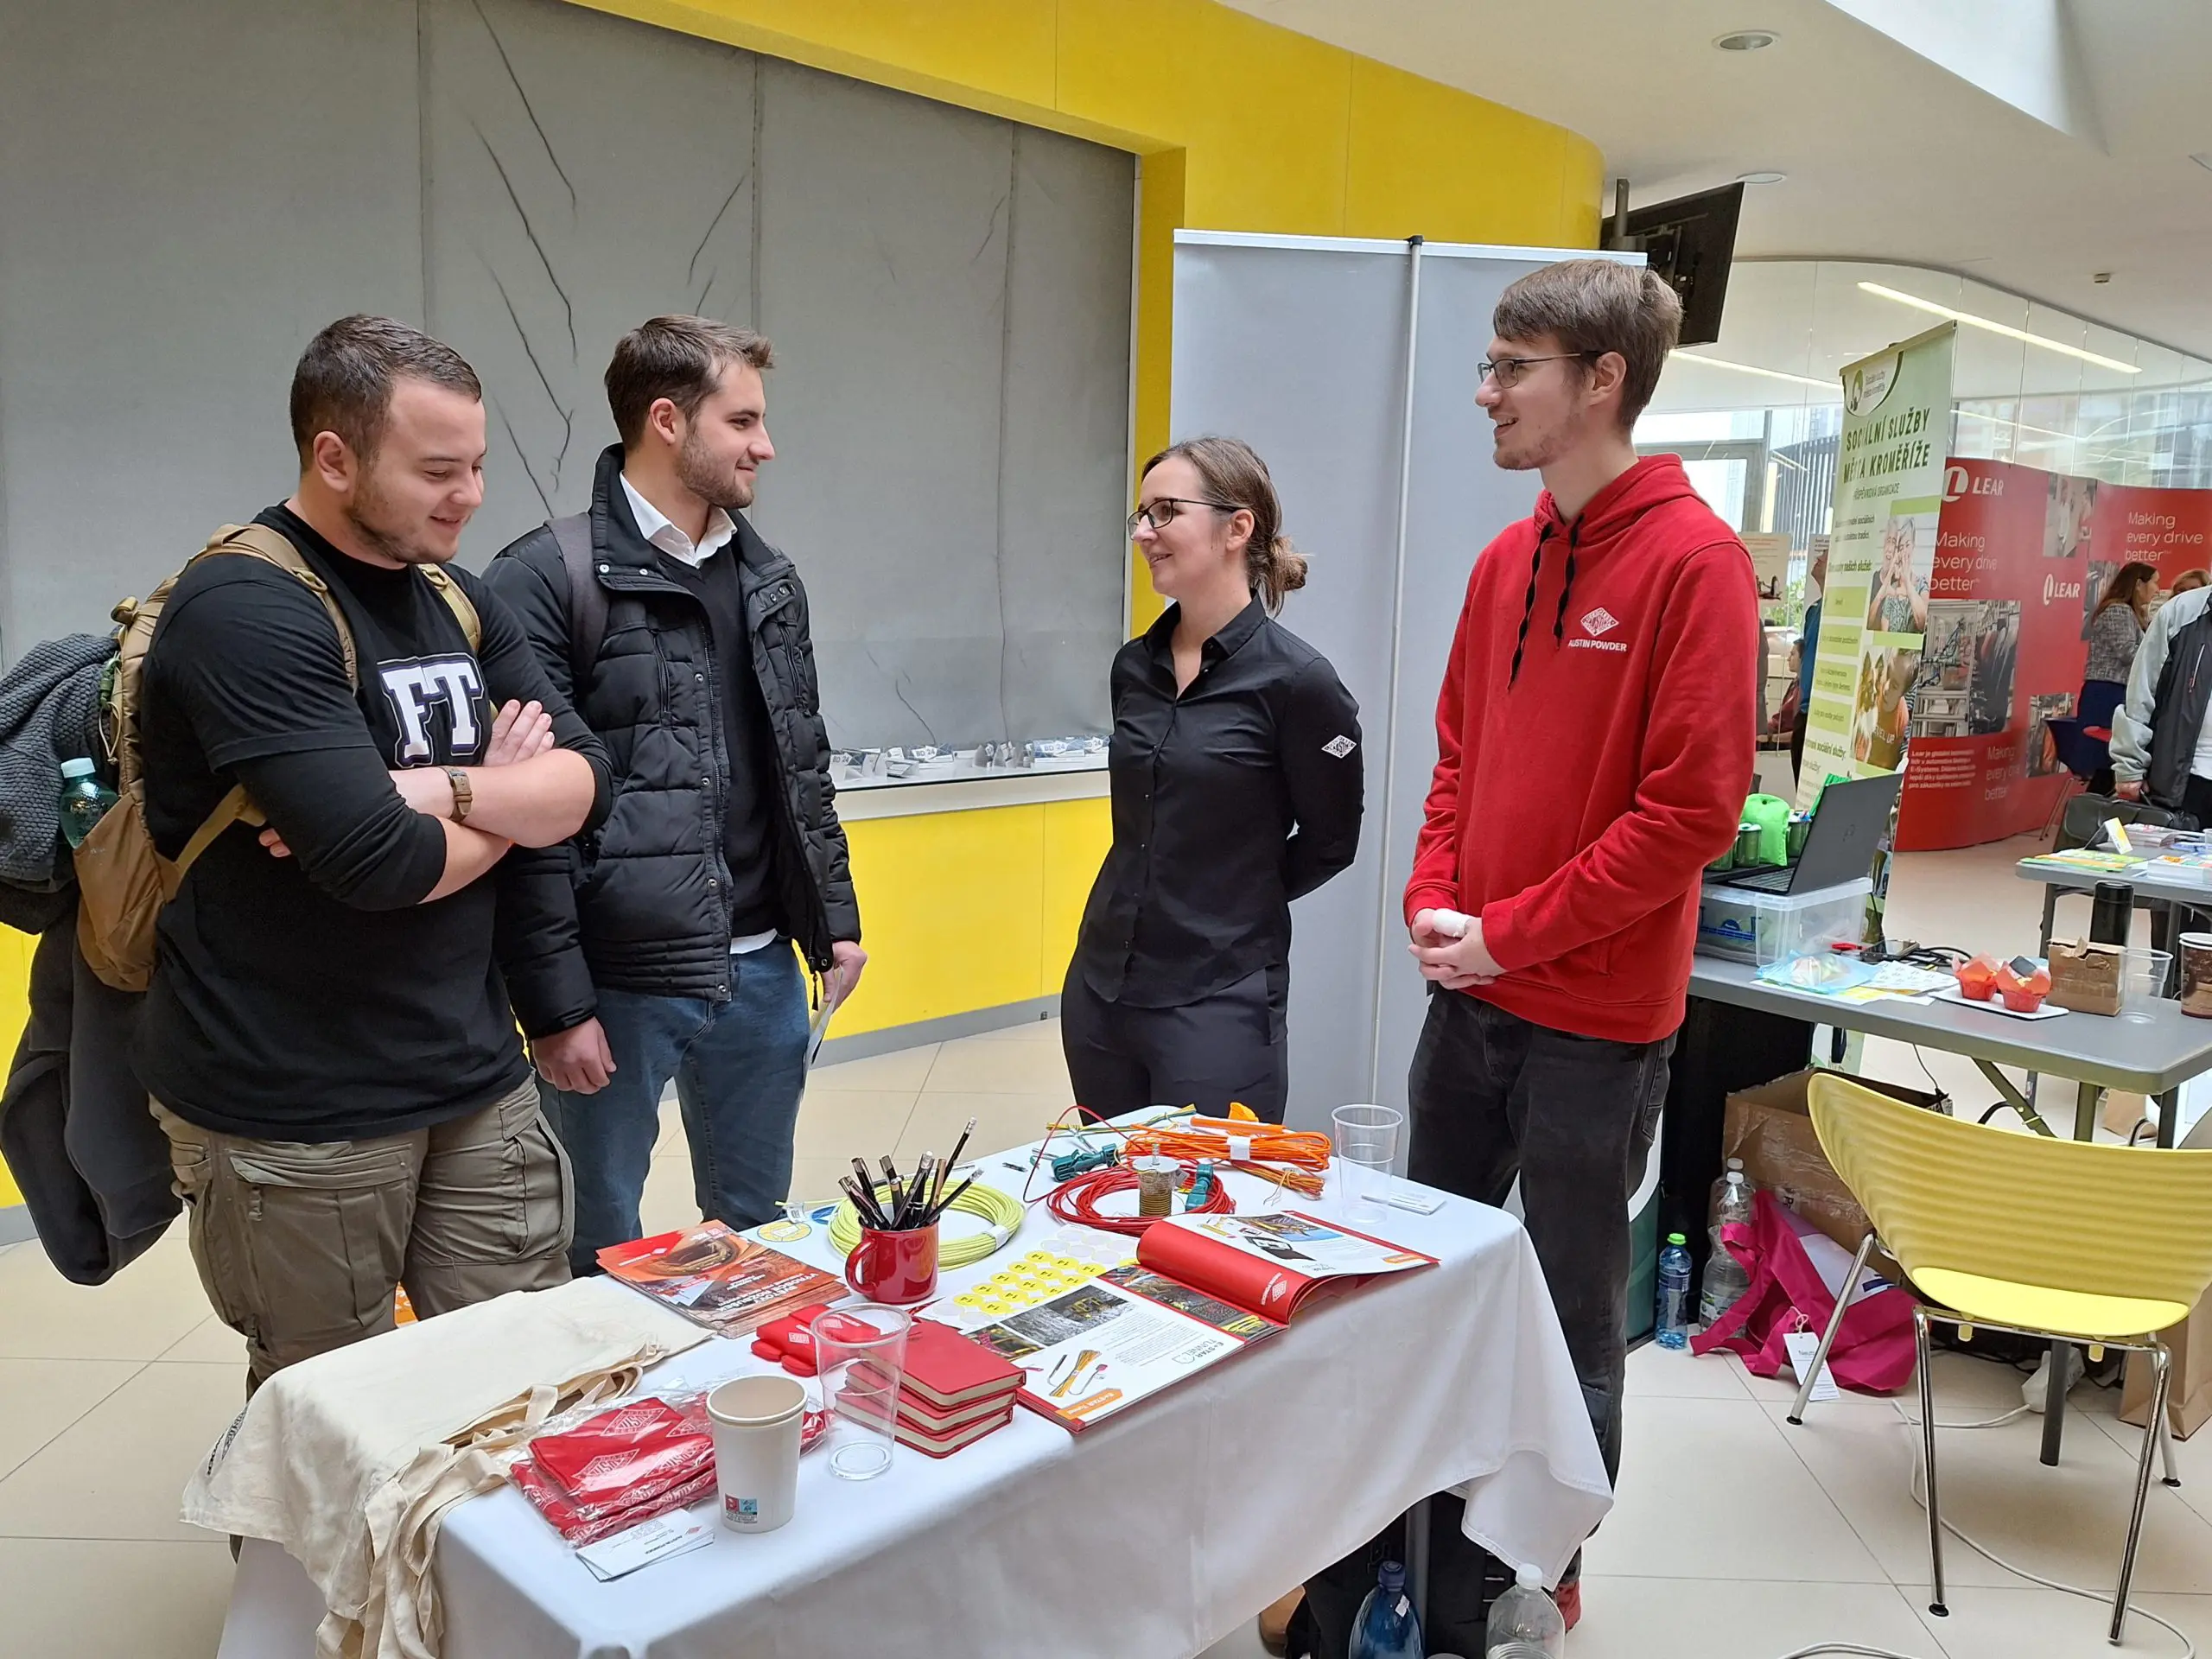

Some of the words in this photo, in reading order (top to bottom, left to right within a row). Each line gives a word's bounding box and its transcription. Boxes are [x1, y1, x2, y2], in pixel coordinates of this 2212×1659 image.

[1846, 415, 1887, 452] SOCIÁLNÍ
[1888, 406, 1930, 440] SLUŽBY
[1869, 440, 1931, 478] KROMĚŘÍŽE
[1973, 477, 2005, 496] LEAR
[2128, 512, 2176, 529] Making
[1936, 531, 1986, 551] Making
[2126, 531, 2161, 546] every
[2164, 531, 2204, 543] drive
[1932, 556, 1975, 573] every
[1975, 555, 1998, 571] drive
[2054, 582, 2081, 598] LEAR
[1568, 639, 1590, 648] AUSTIN
[1591, 639, 1628, 652] POWDER
[378, 654, 483, 767] FT
